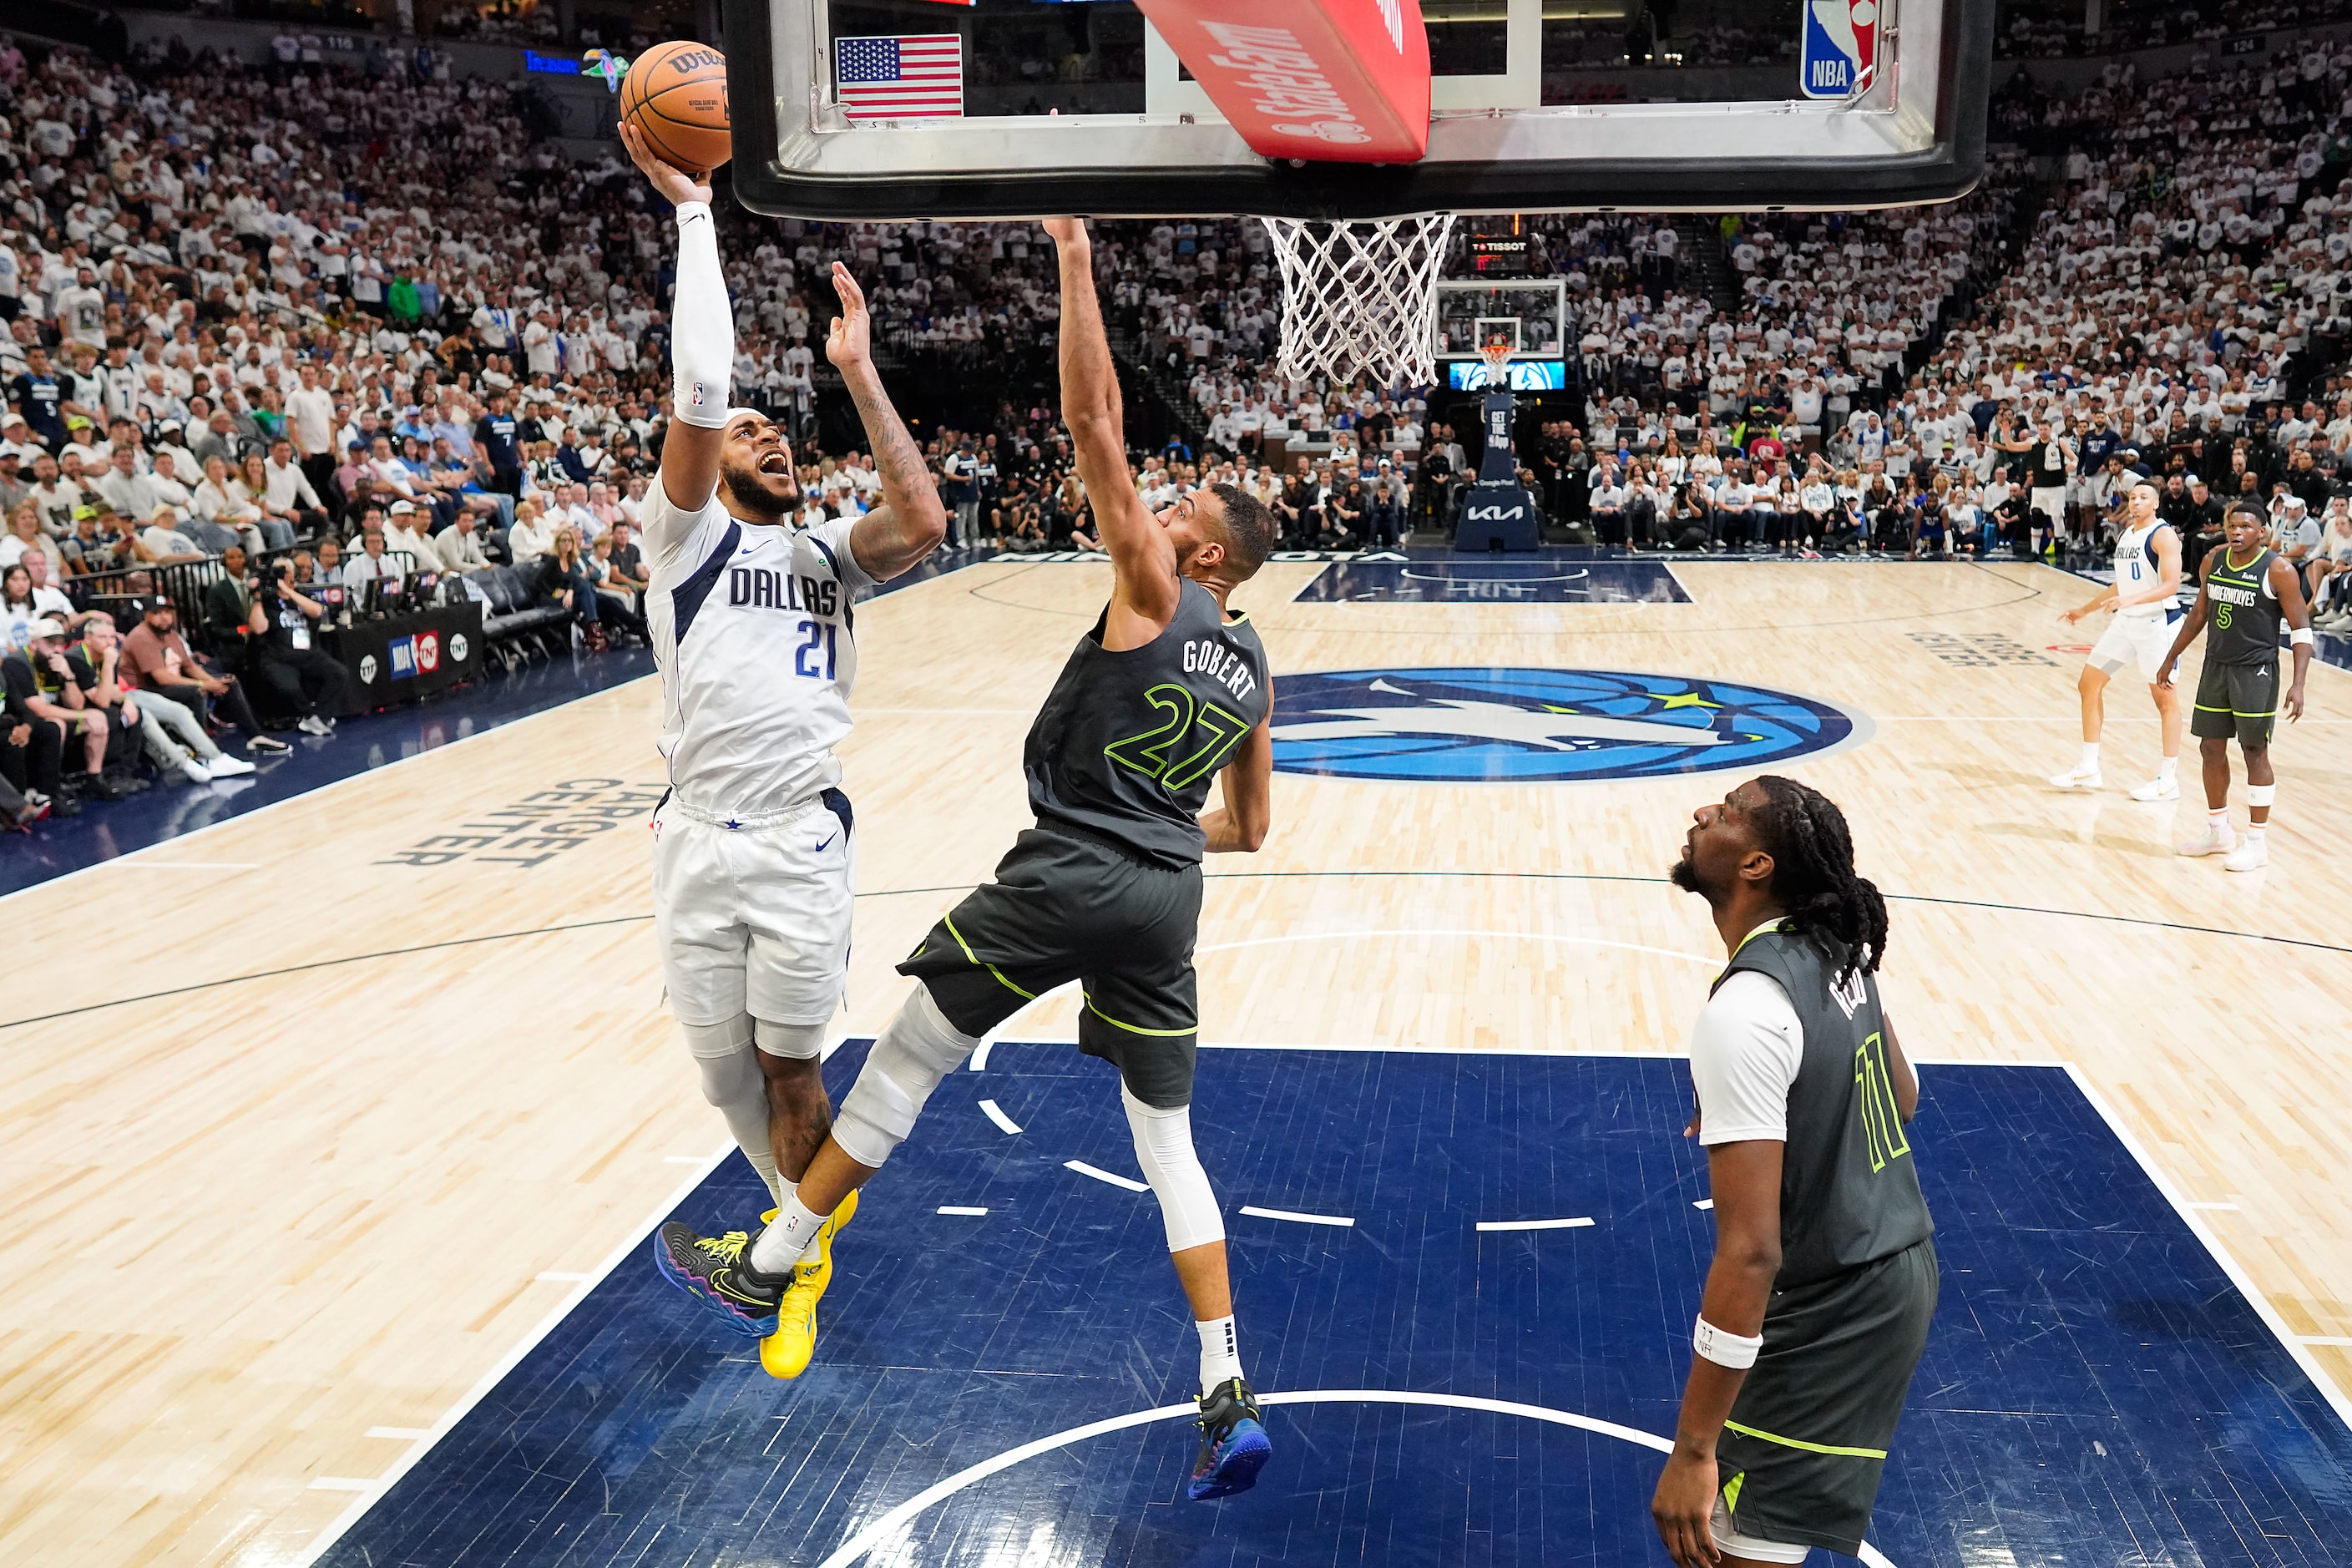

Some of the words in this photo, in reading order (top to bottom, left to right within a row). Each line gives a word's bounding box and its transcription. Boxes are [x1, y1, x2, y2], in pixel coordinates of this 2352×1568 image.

[1813, 60, 1848, 87] NBA
[1486, 242, 1527, 250] TISSOT
[1468, 505, 1524, 520] KIA
[2131, 562, 2141, 580] 0
[728, 568, 837, 618] DALLAS
[2207, 583, 2257, 608] TIMBERWOLVES
[2216, 603, 2233, 630] 5
[392, 644, 412, 673] NBA
[419, 646, 436, 661] TNT
[451, 642, 467, 655] TNT
[793, 620, 837, 681] 21
[1183, 640, 1257, 702] GOBERT
[1103, 683, 1251, 792] 27
[371, 778, 625, 866] CENTER
[1855, 1031, 1911, 1174] 11
